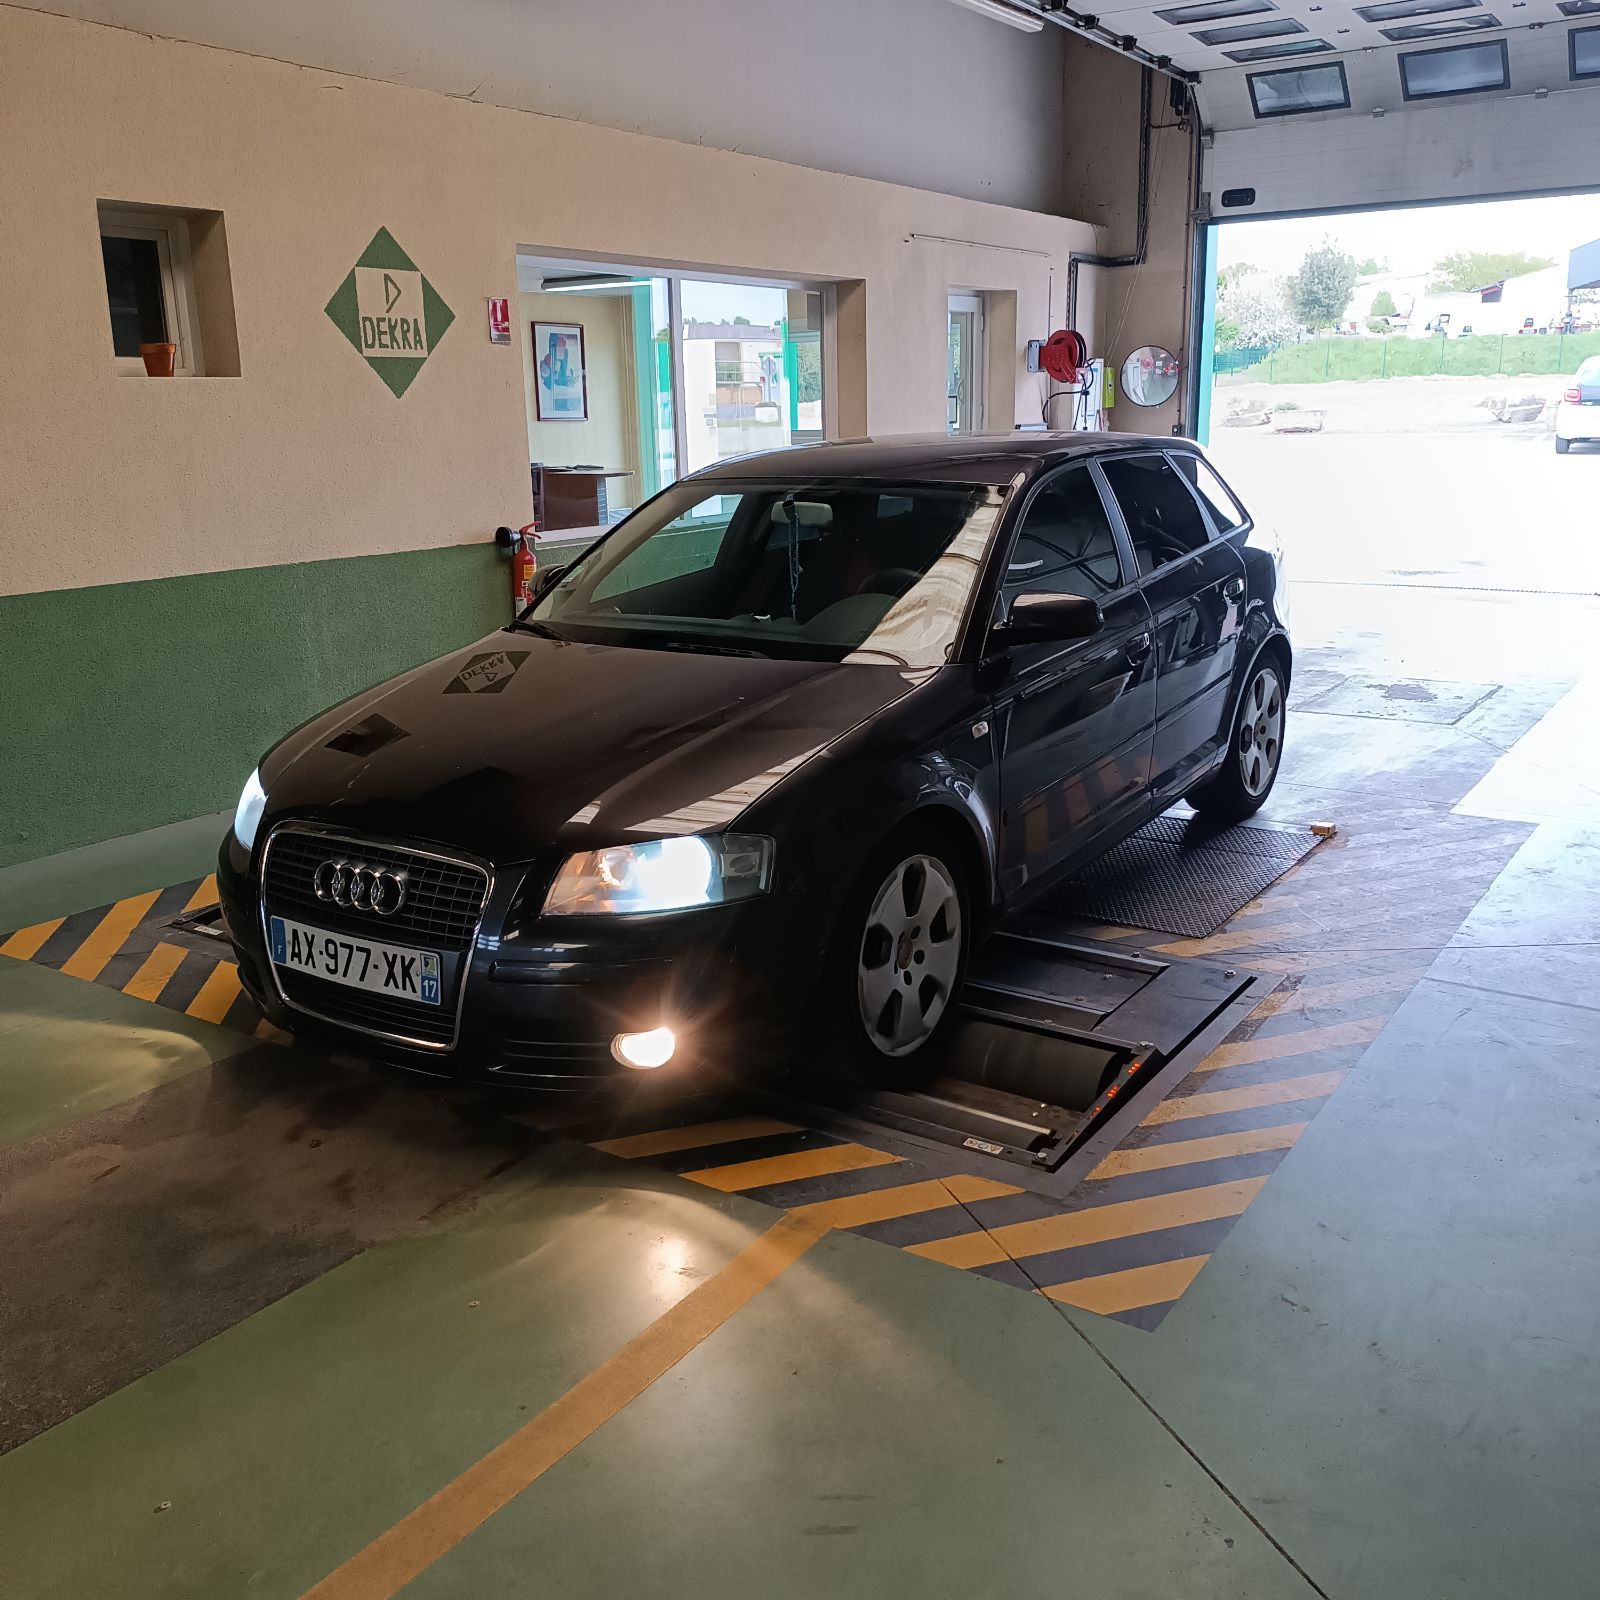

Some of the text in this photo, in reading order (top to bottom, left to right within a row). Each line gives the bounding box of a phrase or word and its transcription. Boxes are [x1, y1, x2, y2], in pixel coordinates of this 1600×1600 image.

[361, 316, 424, 351] DEKRA
[277, 928, 437, 998] F AX-977-XK 17
